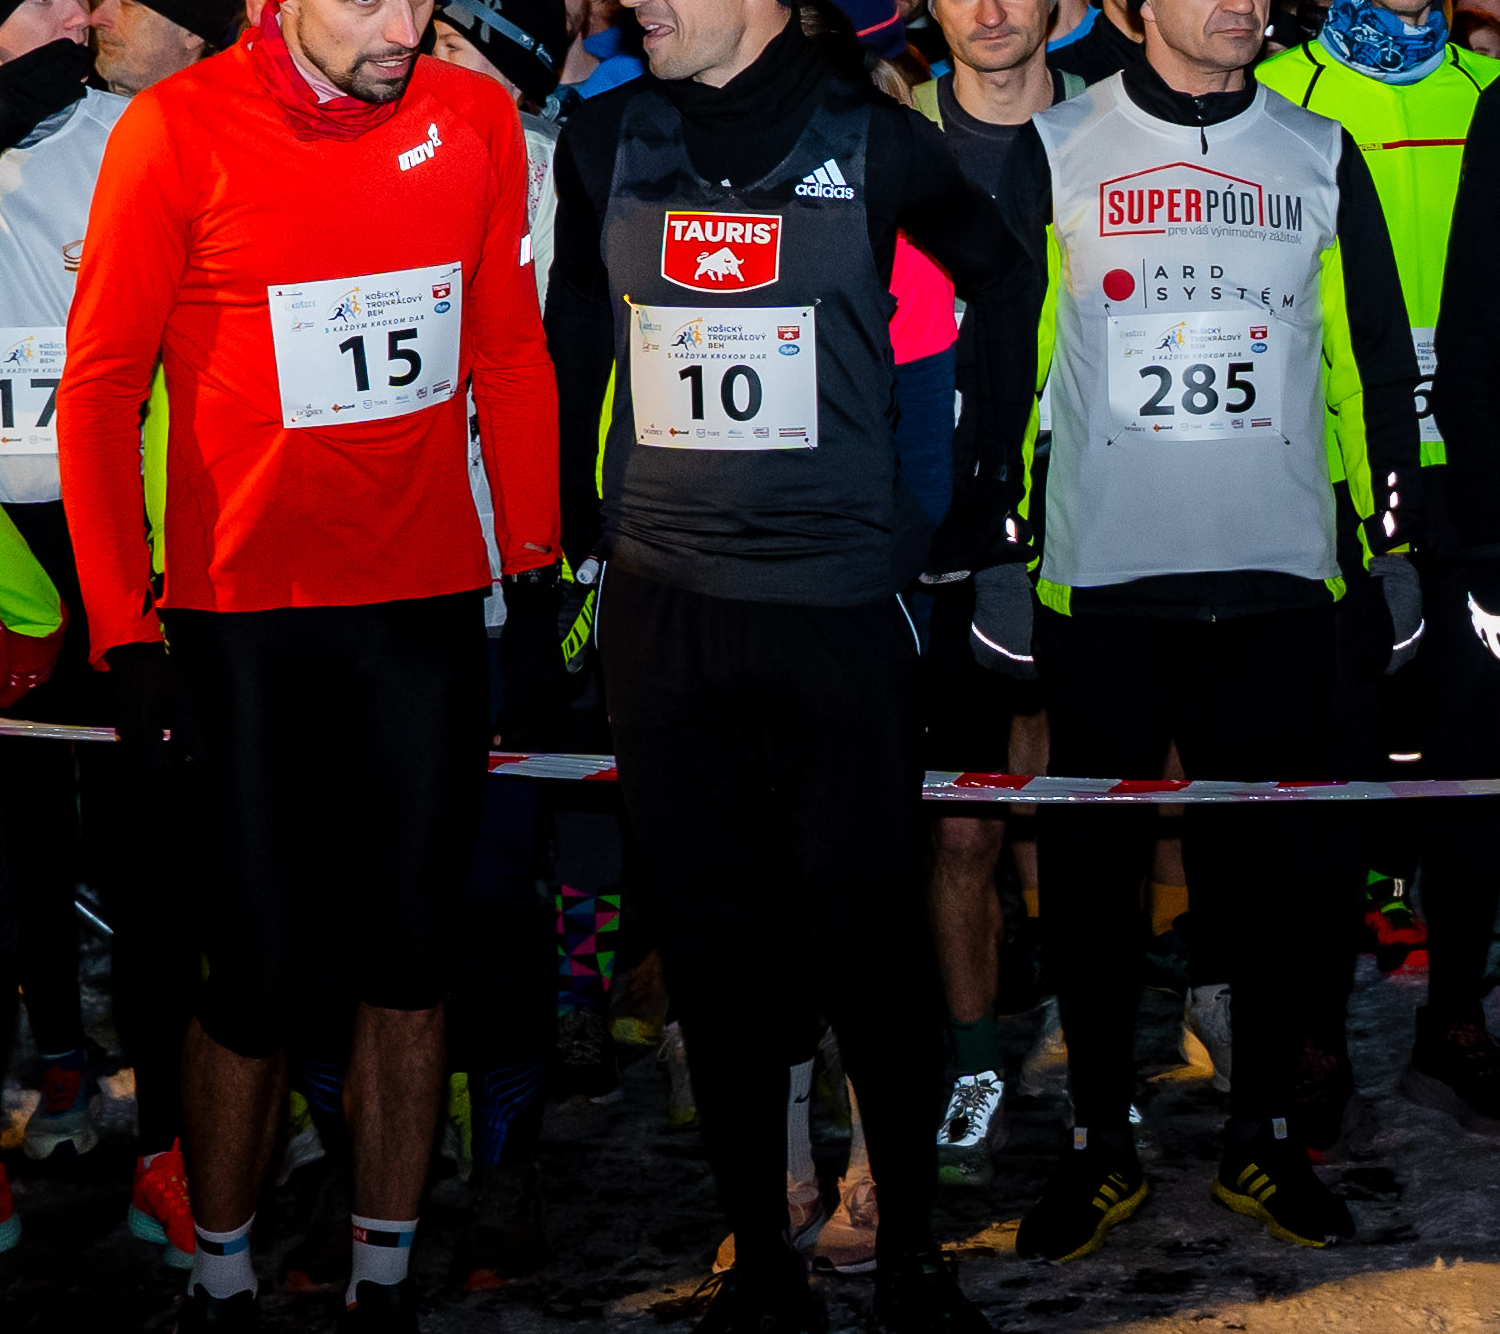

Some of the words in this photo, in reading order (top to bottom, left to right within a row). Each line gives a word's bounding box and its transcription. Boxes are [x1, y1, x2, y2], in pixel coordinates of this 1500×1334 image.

[795, 183, 854, 200] adidas
[670, 221, 771, 245] TAURIS
[1168, 227, 1187, 237] pre
[1190, 225, 1208, 235] váš
[1211, 226, 1267, 241] výnimočný
[1269, 230, 1302, 244] zážitok
[1154, 265, 1223, 279] ARD
[365, 288, 400, 300] KOŠICKÝ
[1156, 287, 1295, 308] SYSTÉM
[367, 309, 384, 317] BEH
[371, 317, 406, 327] KROKOM
[409, 314, 425, 323] DAR
[708, 324, 743, 333] KOŠICKÝ
[338, 328, 422, 392] 15
[678, 364, 762, 421] 10
[1139, 362, 1256, 416] 285
